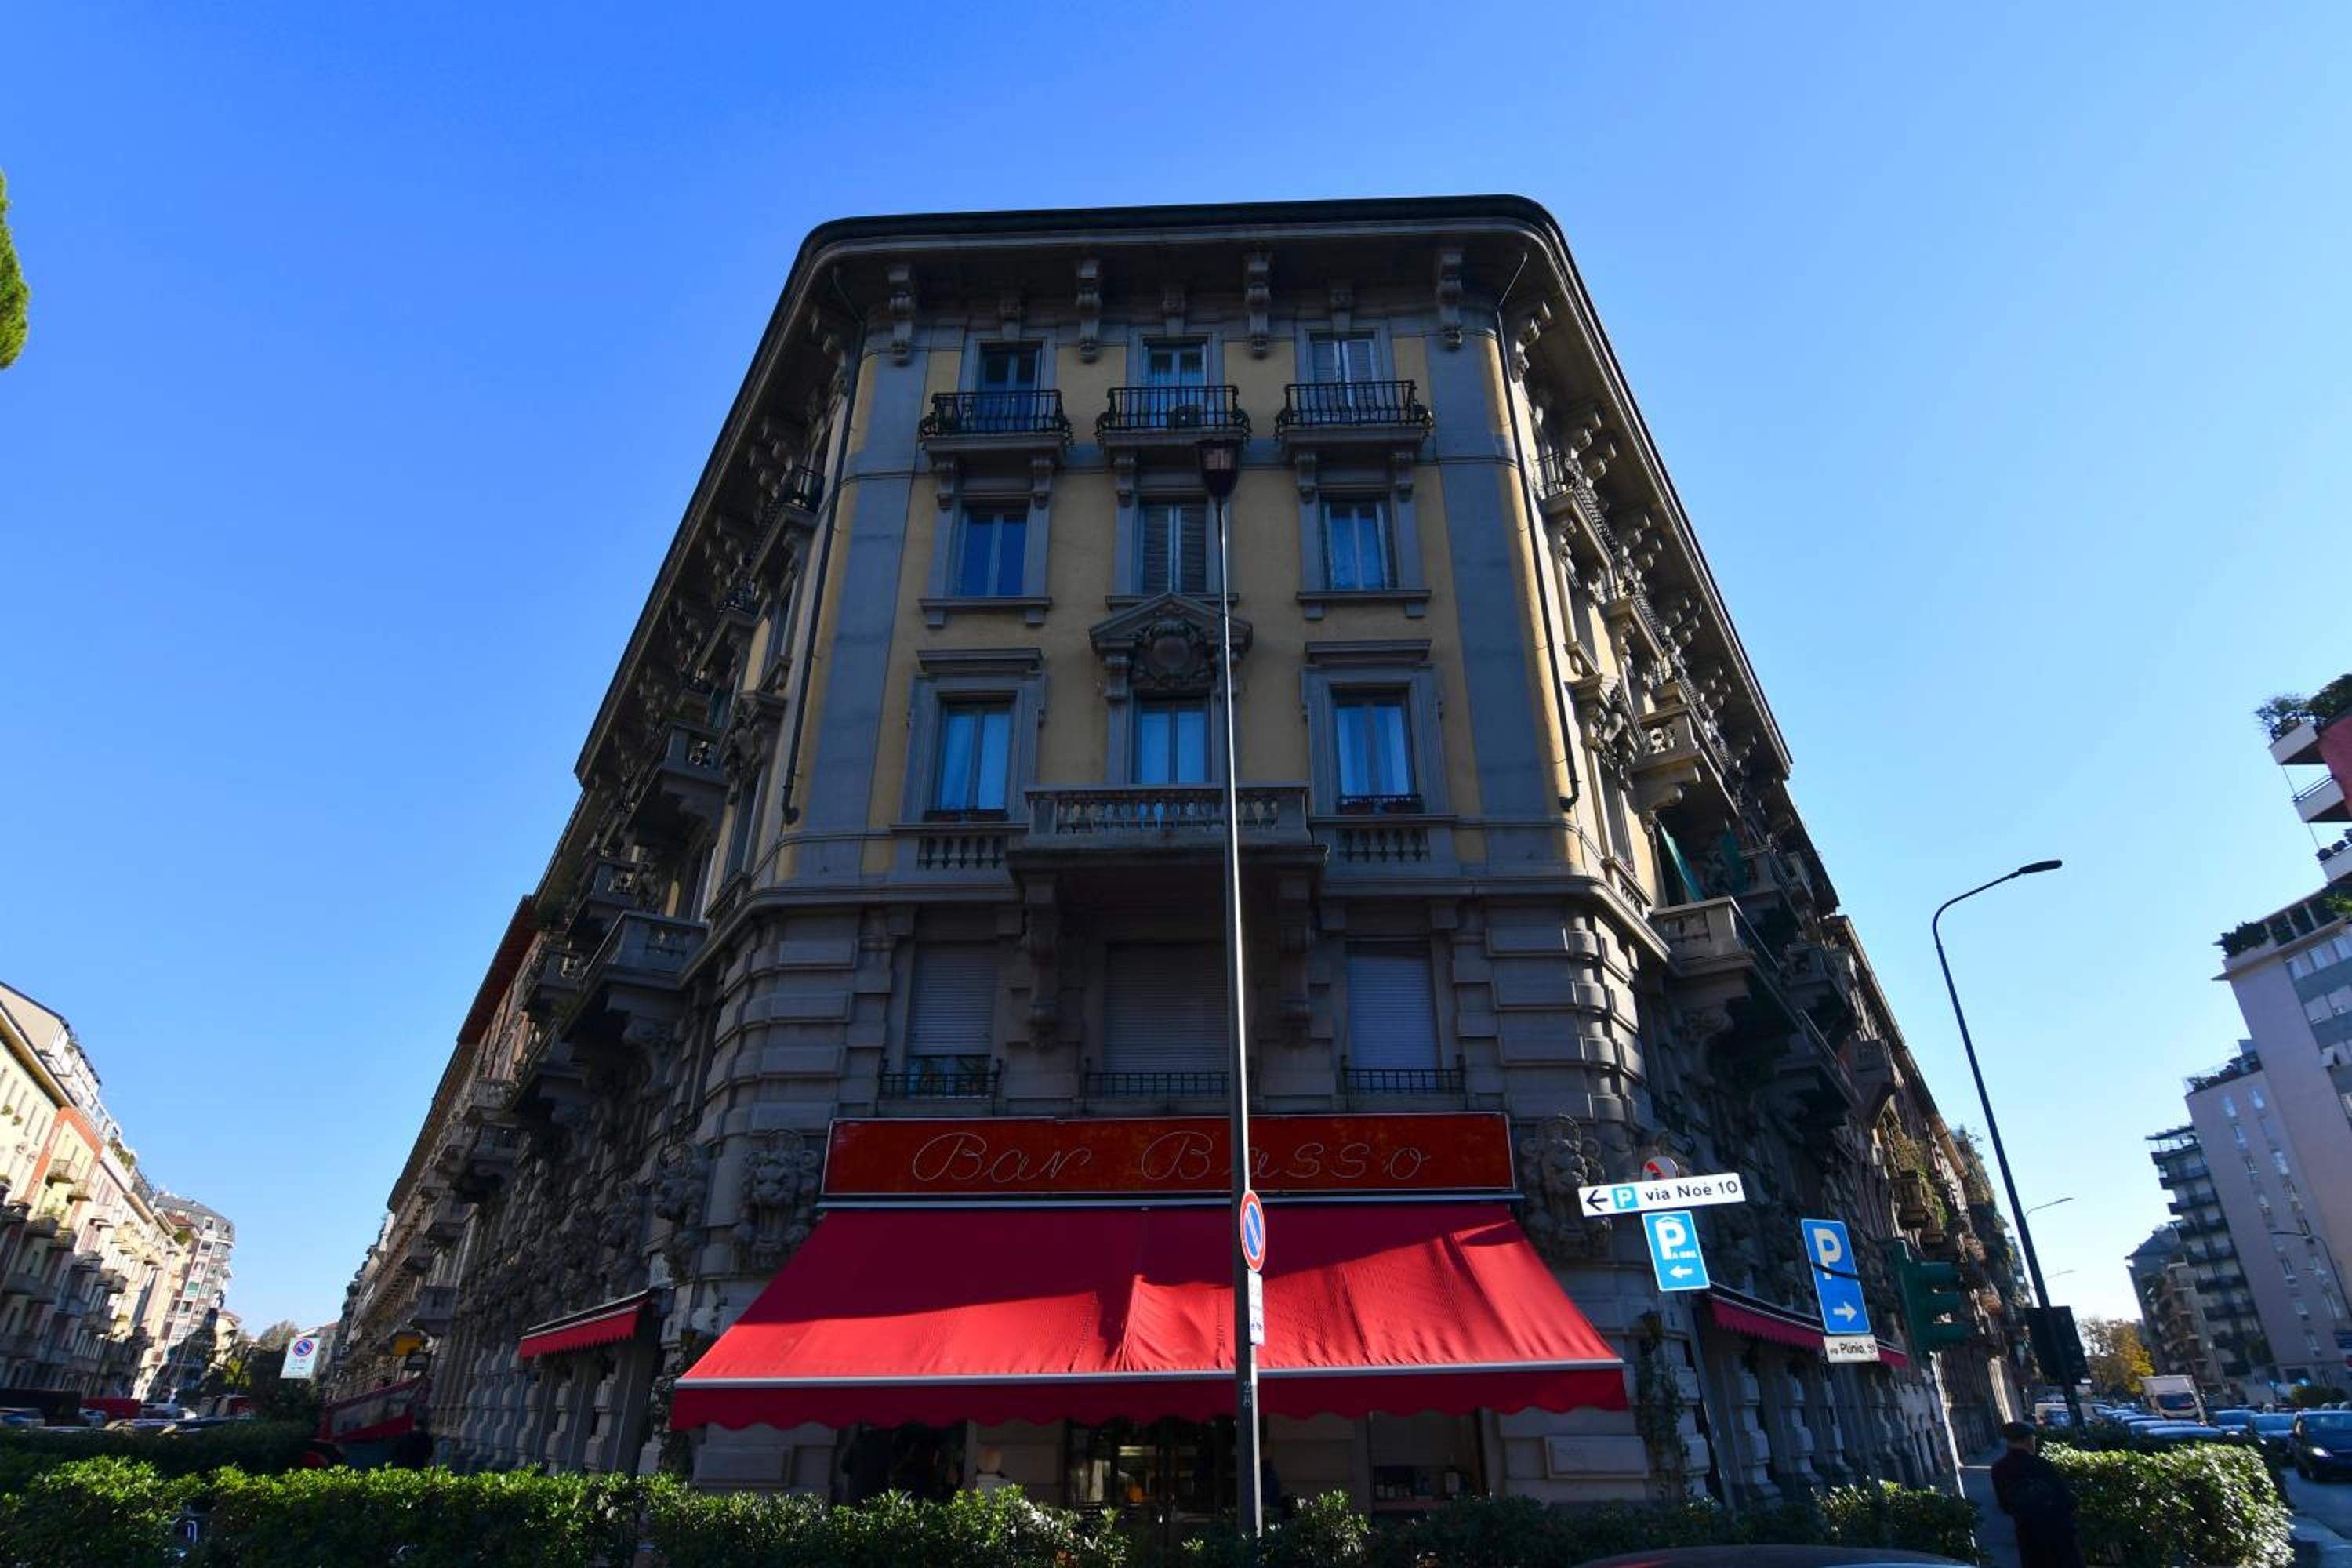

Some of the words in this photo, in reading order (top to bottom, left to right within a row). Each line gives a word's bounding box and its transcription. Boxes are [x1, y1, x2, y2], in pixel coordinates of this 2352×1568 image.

[913, 1131, 1093, 1182] Bar
[1616, 1189, 1632, 1208] P
[1646, 1187, 1671, 1201] via
[1718, 1180, 1738, 1194] 10
[1655, 1221, 1686, 1261] P
[1813, 1228, 1842, 1280] P
